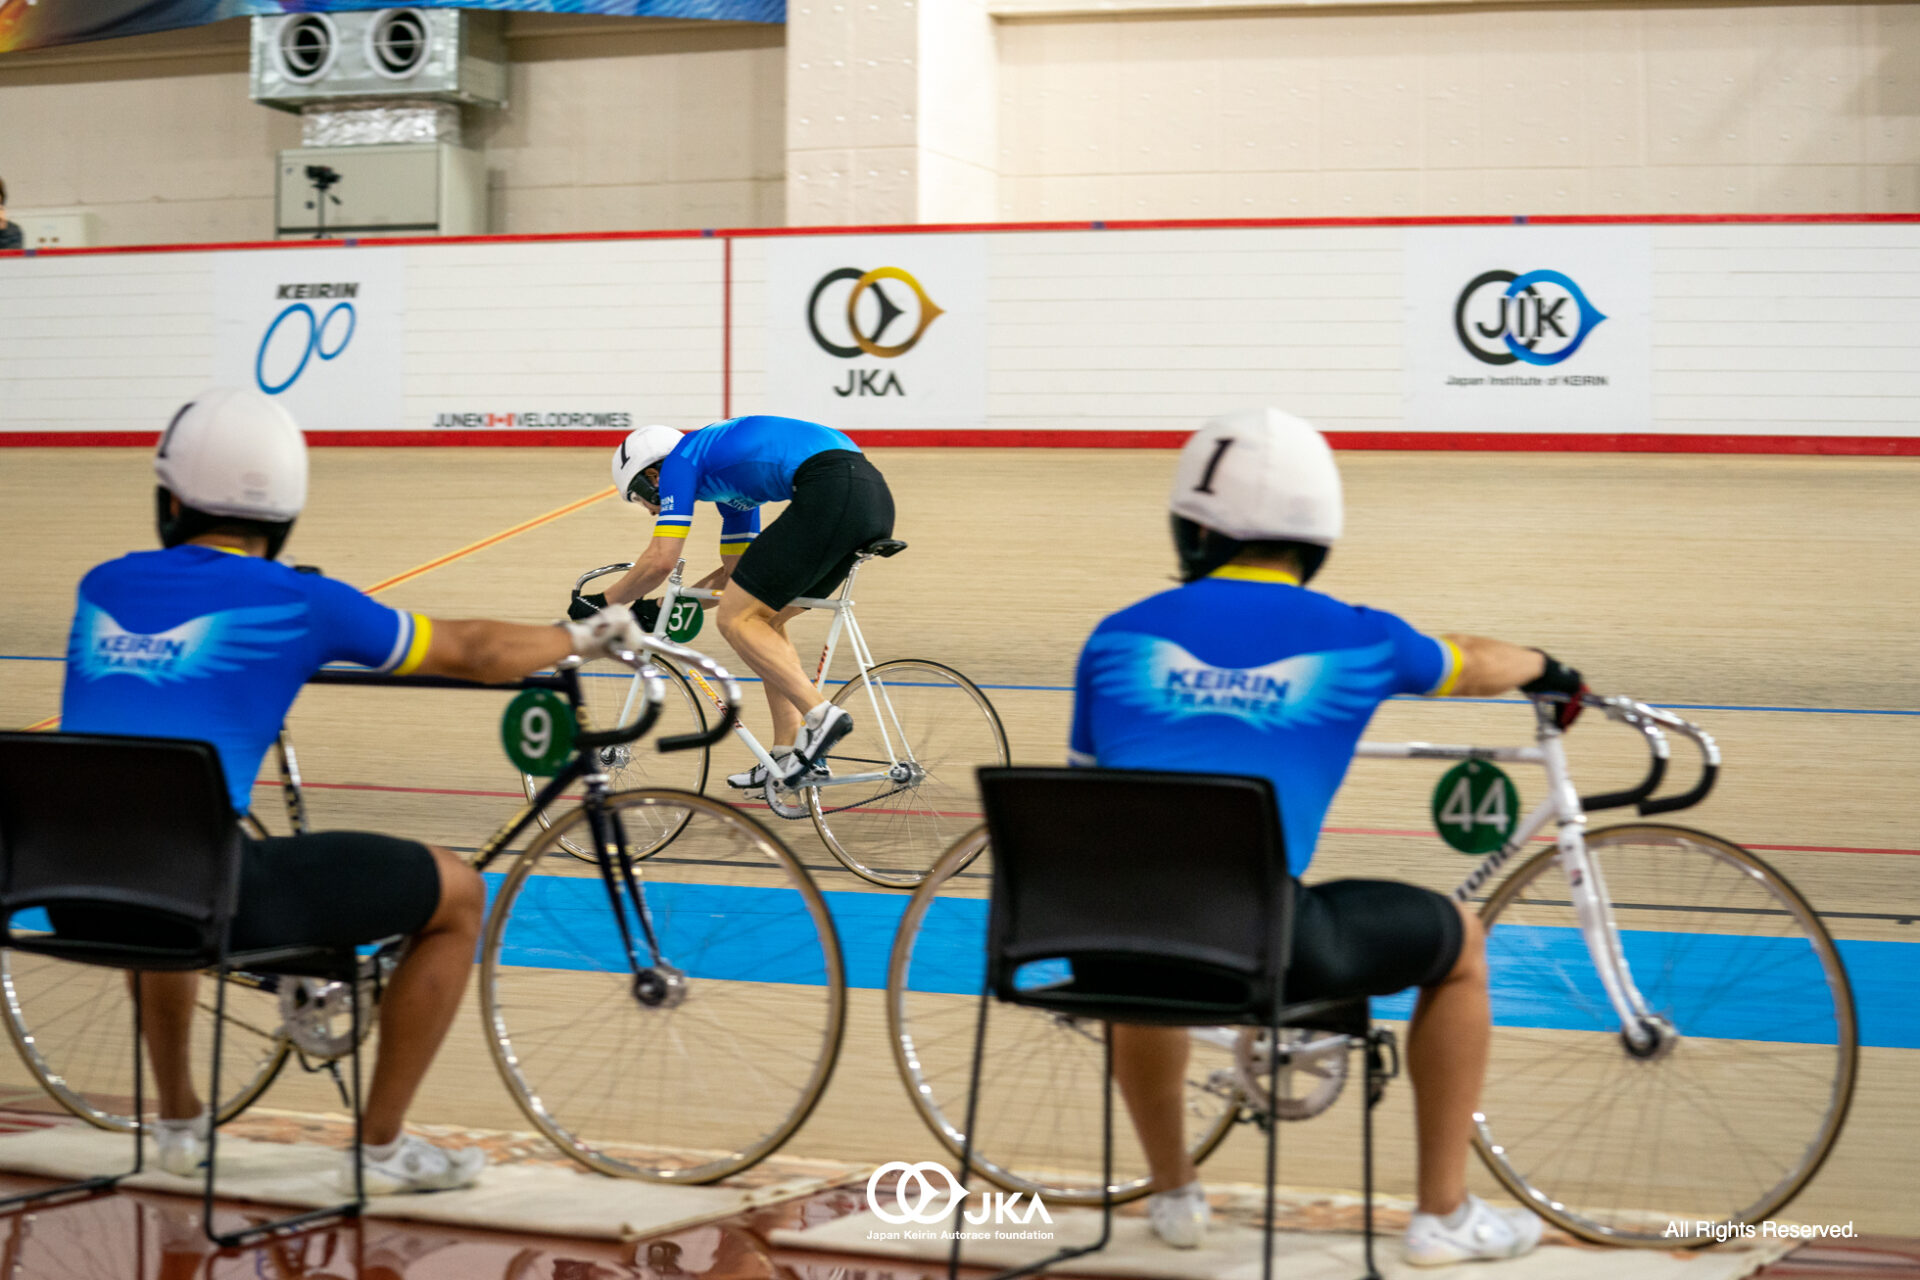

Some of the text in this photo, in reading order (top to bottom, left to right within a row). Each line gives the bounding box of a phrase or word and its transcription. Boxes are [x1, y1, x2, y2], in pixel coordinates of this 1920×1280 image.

[276, 282, 359, 300] KEIRIN
[1475, 297, 1568, 339] JIK
[833, 369, 906, 397] JKA
[1446, 376, 1484, 387] Japan
[1489, 376, 1541, 386] Institute
[1563, 376, 1608, 387] KEIRIN
[434, 413, 631, 428] JUNEK VELODROMES
[668, 602, 699, 632] 37
[1167, 668, 1290, 700] KEIRIN
[520, 706, 552, 759] 9
[1439, 776, 1510, 834] 44
